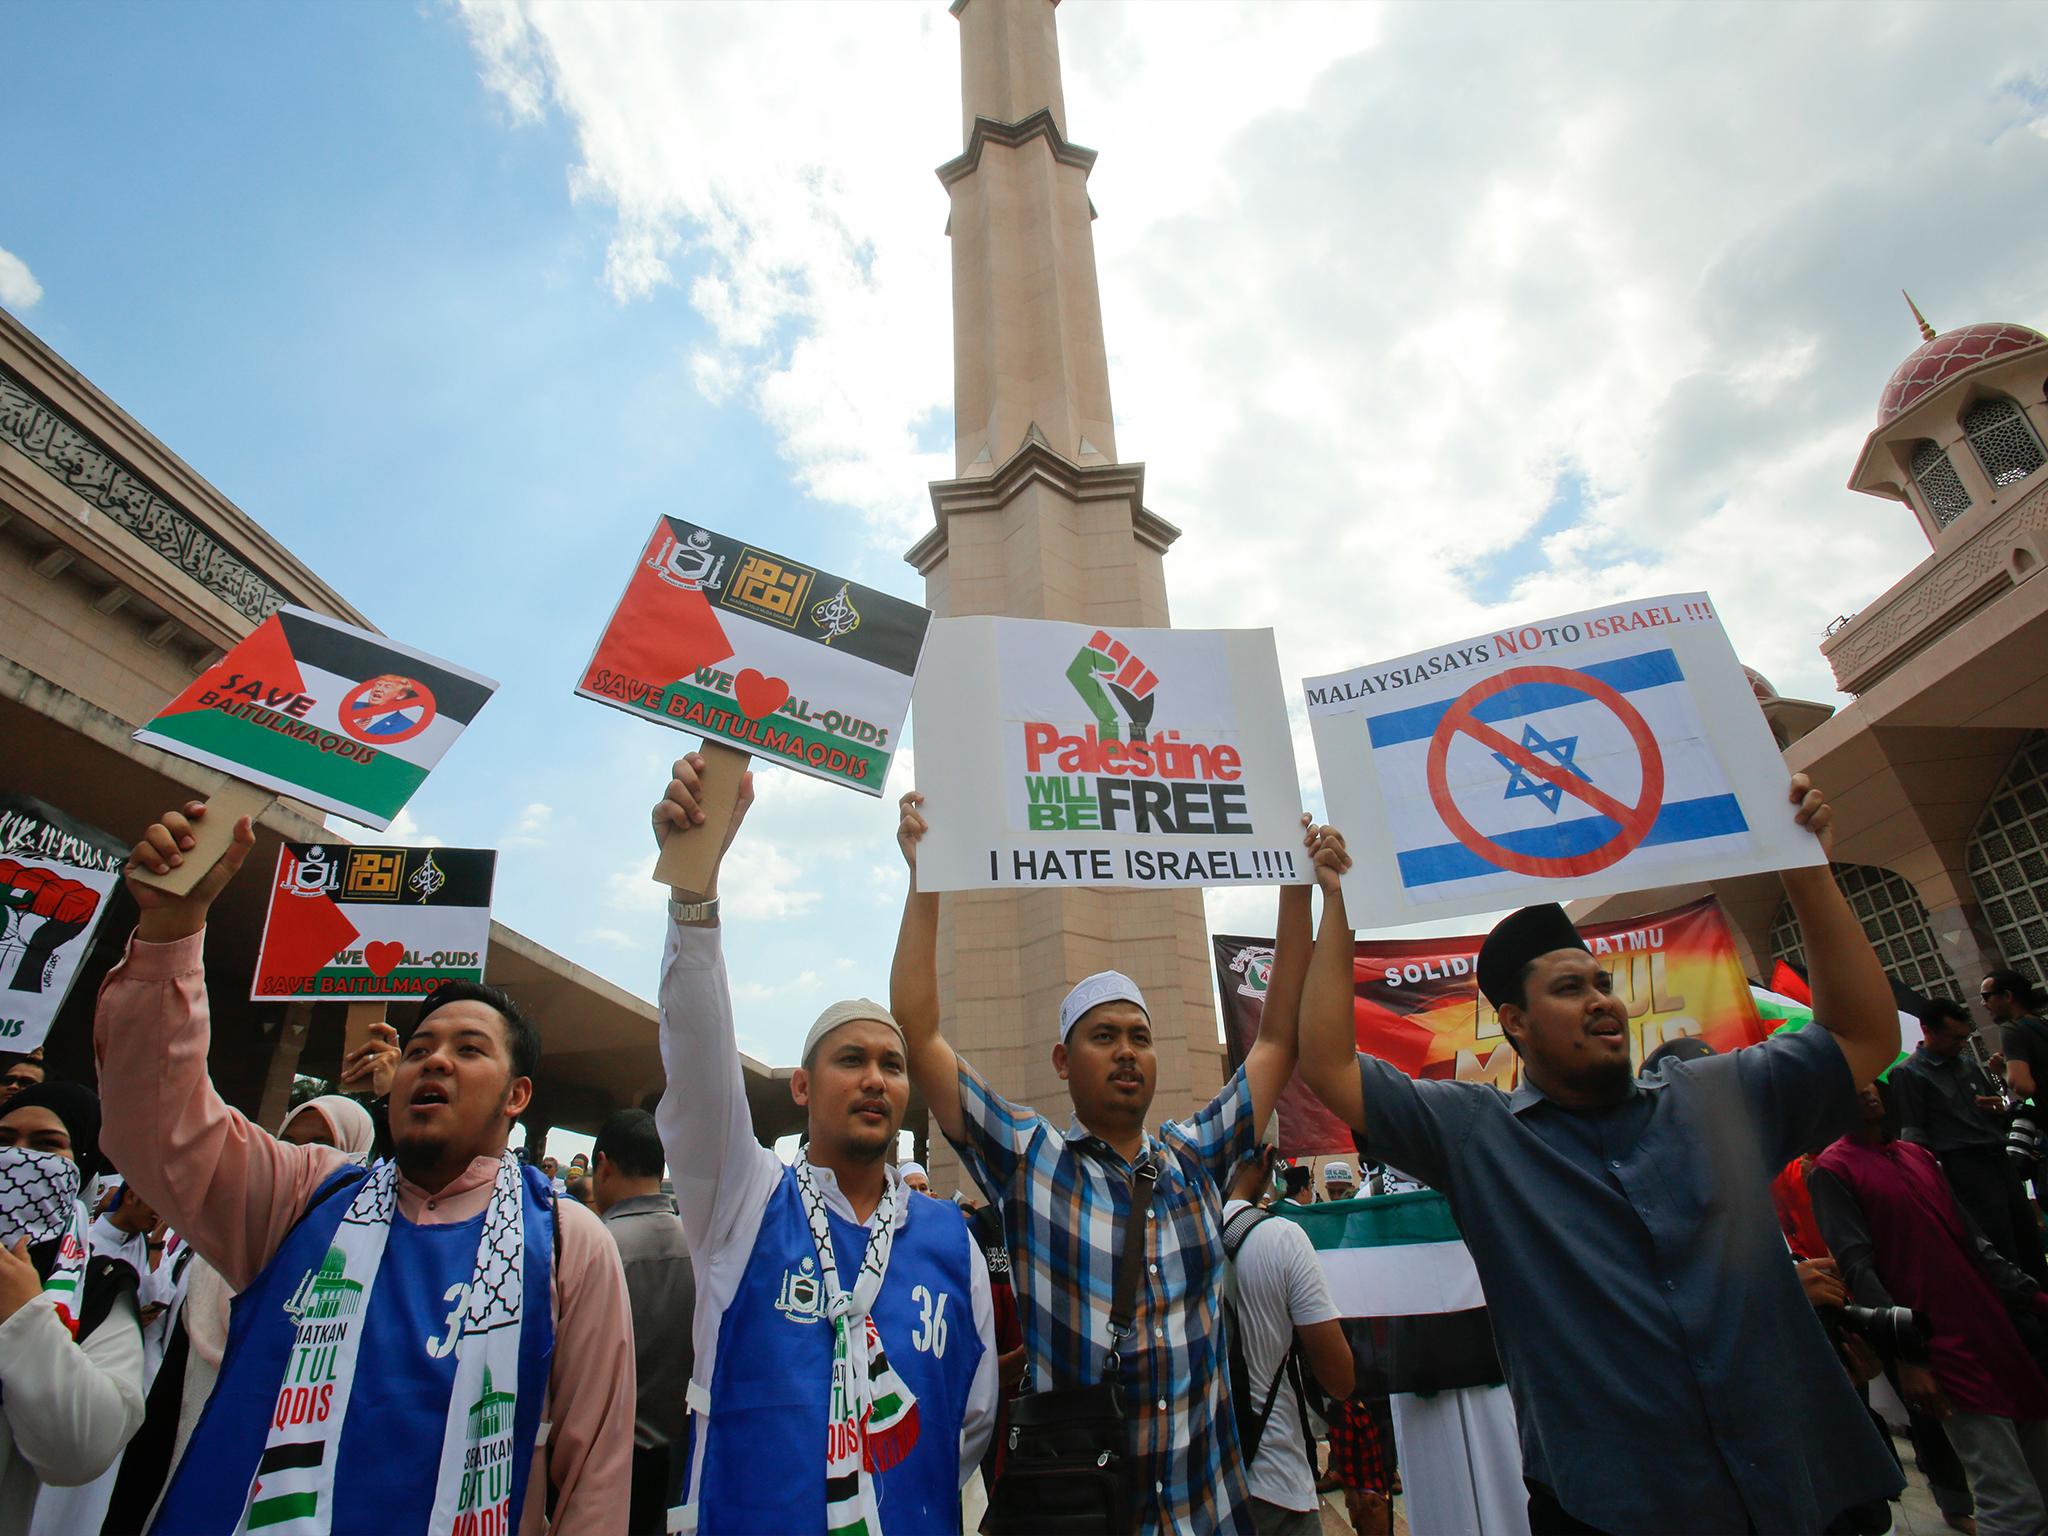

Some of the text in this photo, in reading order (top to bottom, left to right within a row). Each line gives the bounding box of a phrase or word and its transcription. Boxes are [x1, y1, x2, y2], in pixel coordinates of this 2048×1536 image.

[1493, 627, 1543, 658] NO
[1542, 624, 1580, 647] TO
[1583, 606, 1681, 640] ISRAEL
[220, 672, 317, 719] SAVE
[694, 664, 889, 747] WE AL-QUDS
[198, 690, 379, 766] BAITULMAQDIS
[592, 669, 869, 780] SAVE BAITULMAQDIS
[1023, 721, 1243, 782] Palestine
[1024, 775, 1254, 835] WILL FREE
[1027, 803, 1101, 832] BE
[989, 849, 999, 881] I
[1012, 849, 1114, 881] HATE
[263, 976, 316, 994] SAVE
[333, 950, 479, 968] WE AL-QUDS
[911, 1285, 948, 1360] 36
